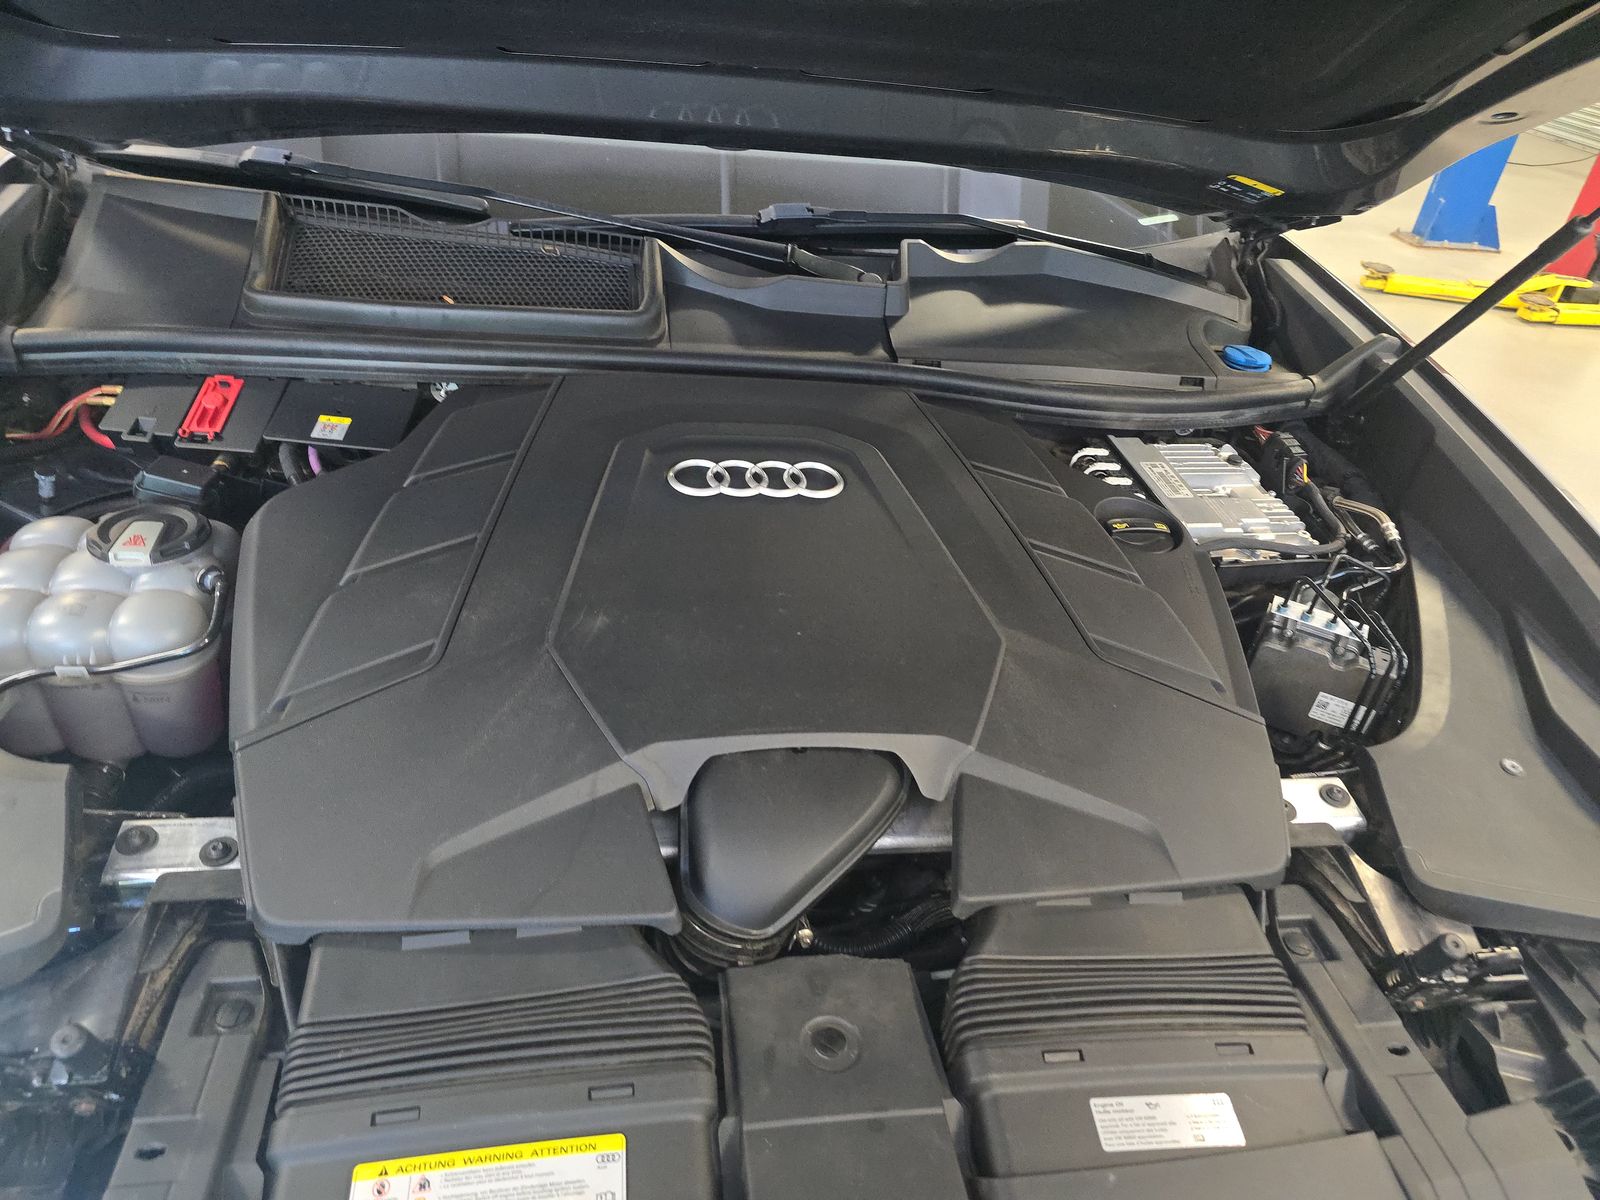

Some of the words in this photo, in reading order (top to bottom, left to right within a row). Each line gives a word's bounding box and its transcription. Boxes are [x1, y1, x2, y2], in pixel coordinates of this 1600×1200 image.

[396, 1158, 456, 1174] ACHTUNG
[463, 1150, 523, 1166] WARNING
[530, 1143, 597, 1158] ATTENTION
